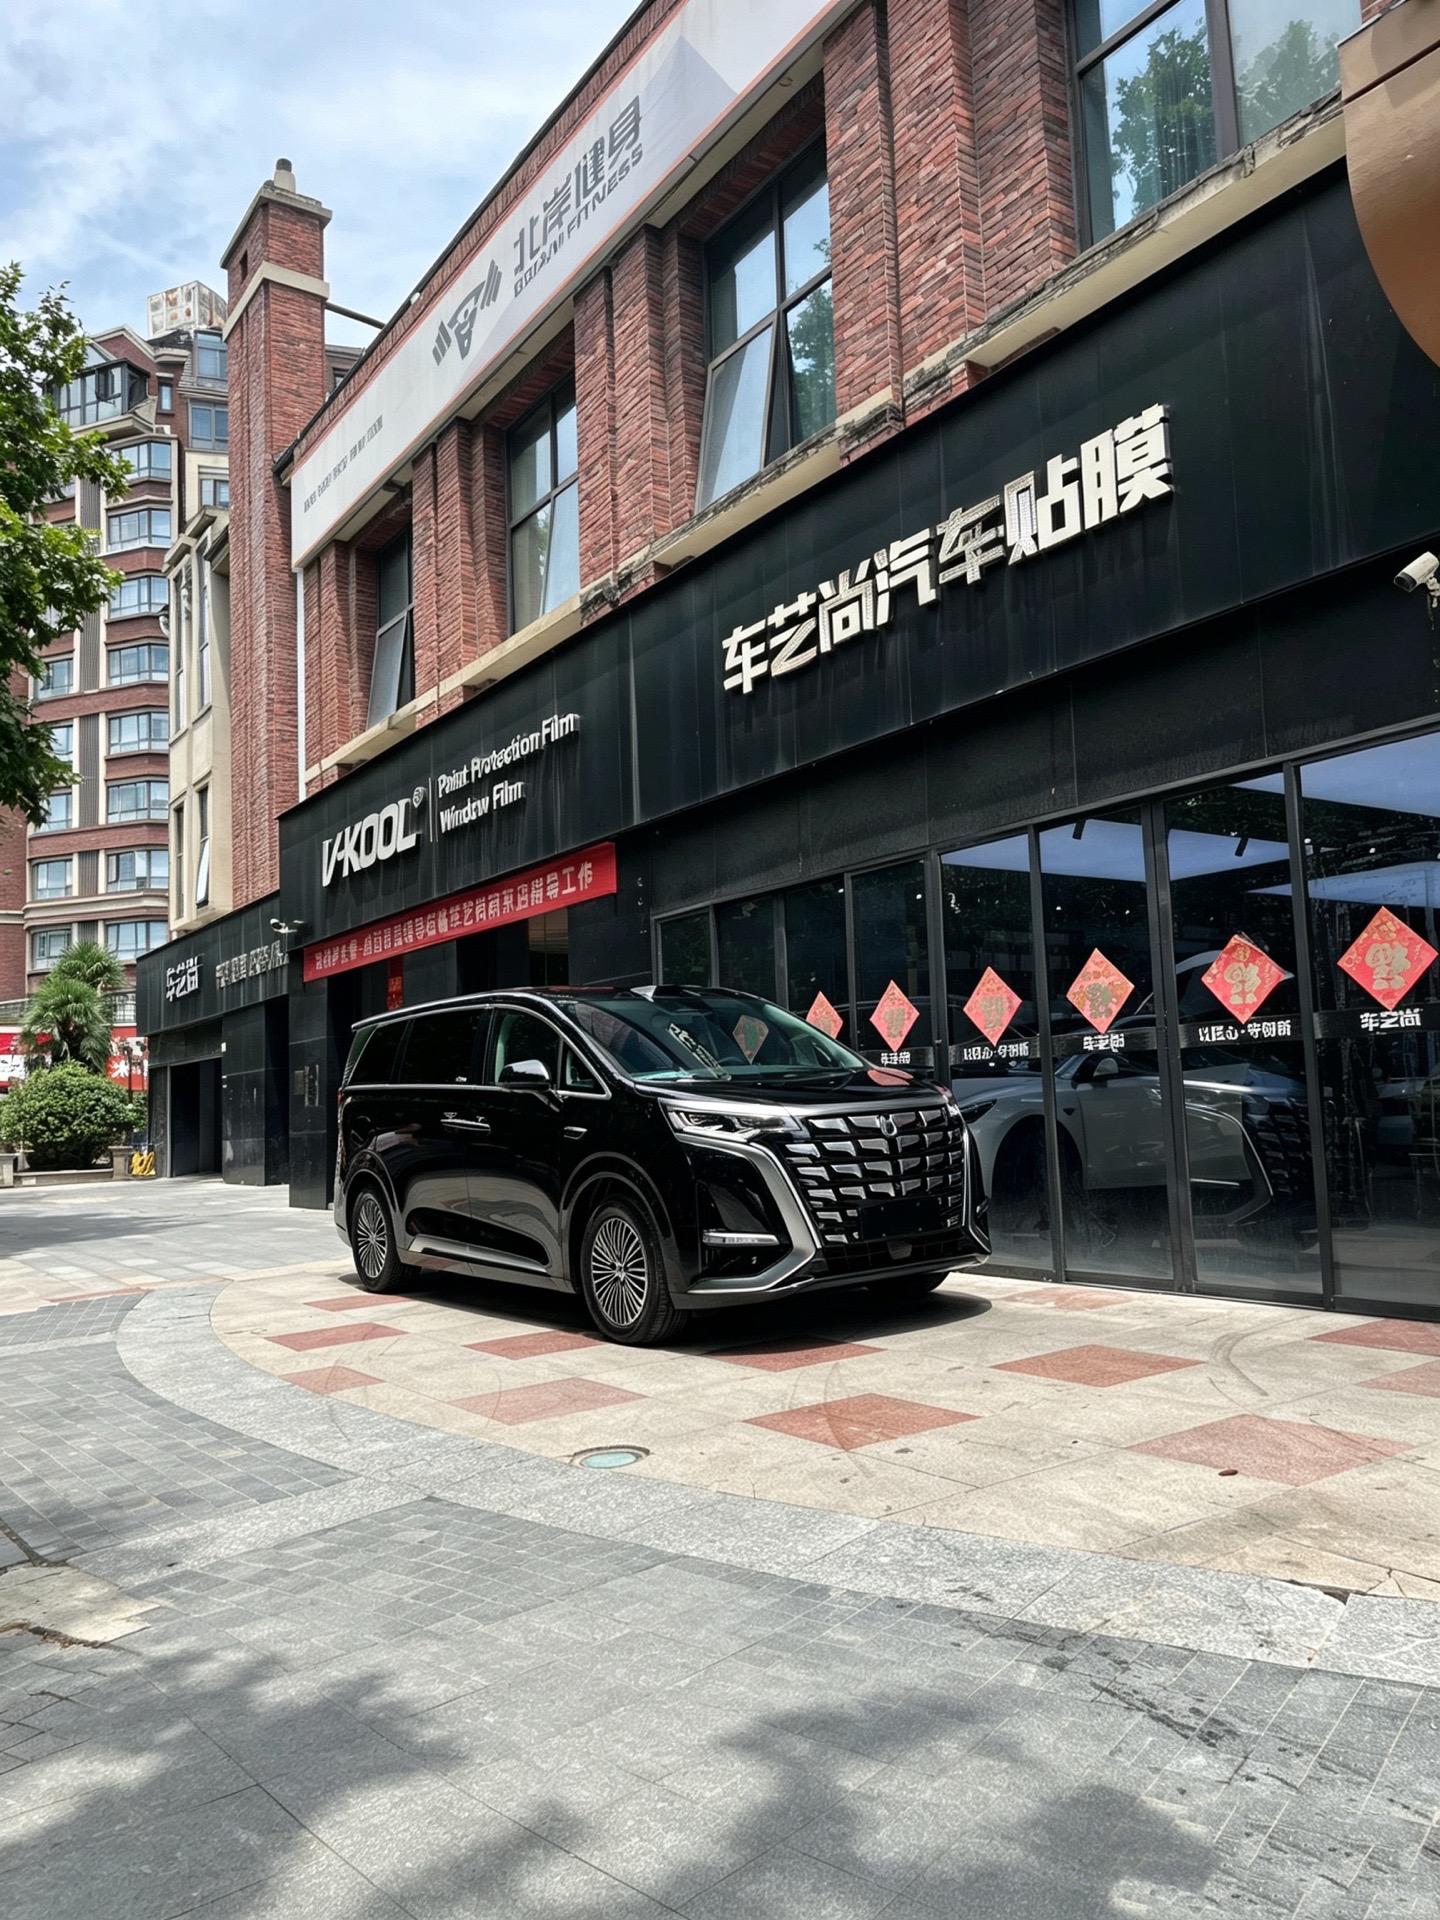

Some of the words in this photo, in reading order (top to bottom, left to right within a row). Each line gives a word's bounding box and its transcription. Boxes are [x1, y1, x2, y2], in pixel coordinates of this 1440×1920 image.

[513, 95, 643, 277] 北岸健身
[567, 142, 644, 240] FITNESS
[721, 403, 1175, 694] 车艺尚汽车贴膜
[437, 764, 470, 798] Paint
[470, 733, 542, 784] Protection
[541, 713, 580, 748] Film
[439, 797, 489, 833] Window
[492, 779, 526, 810] Film
